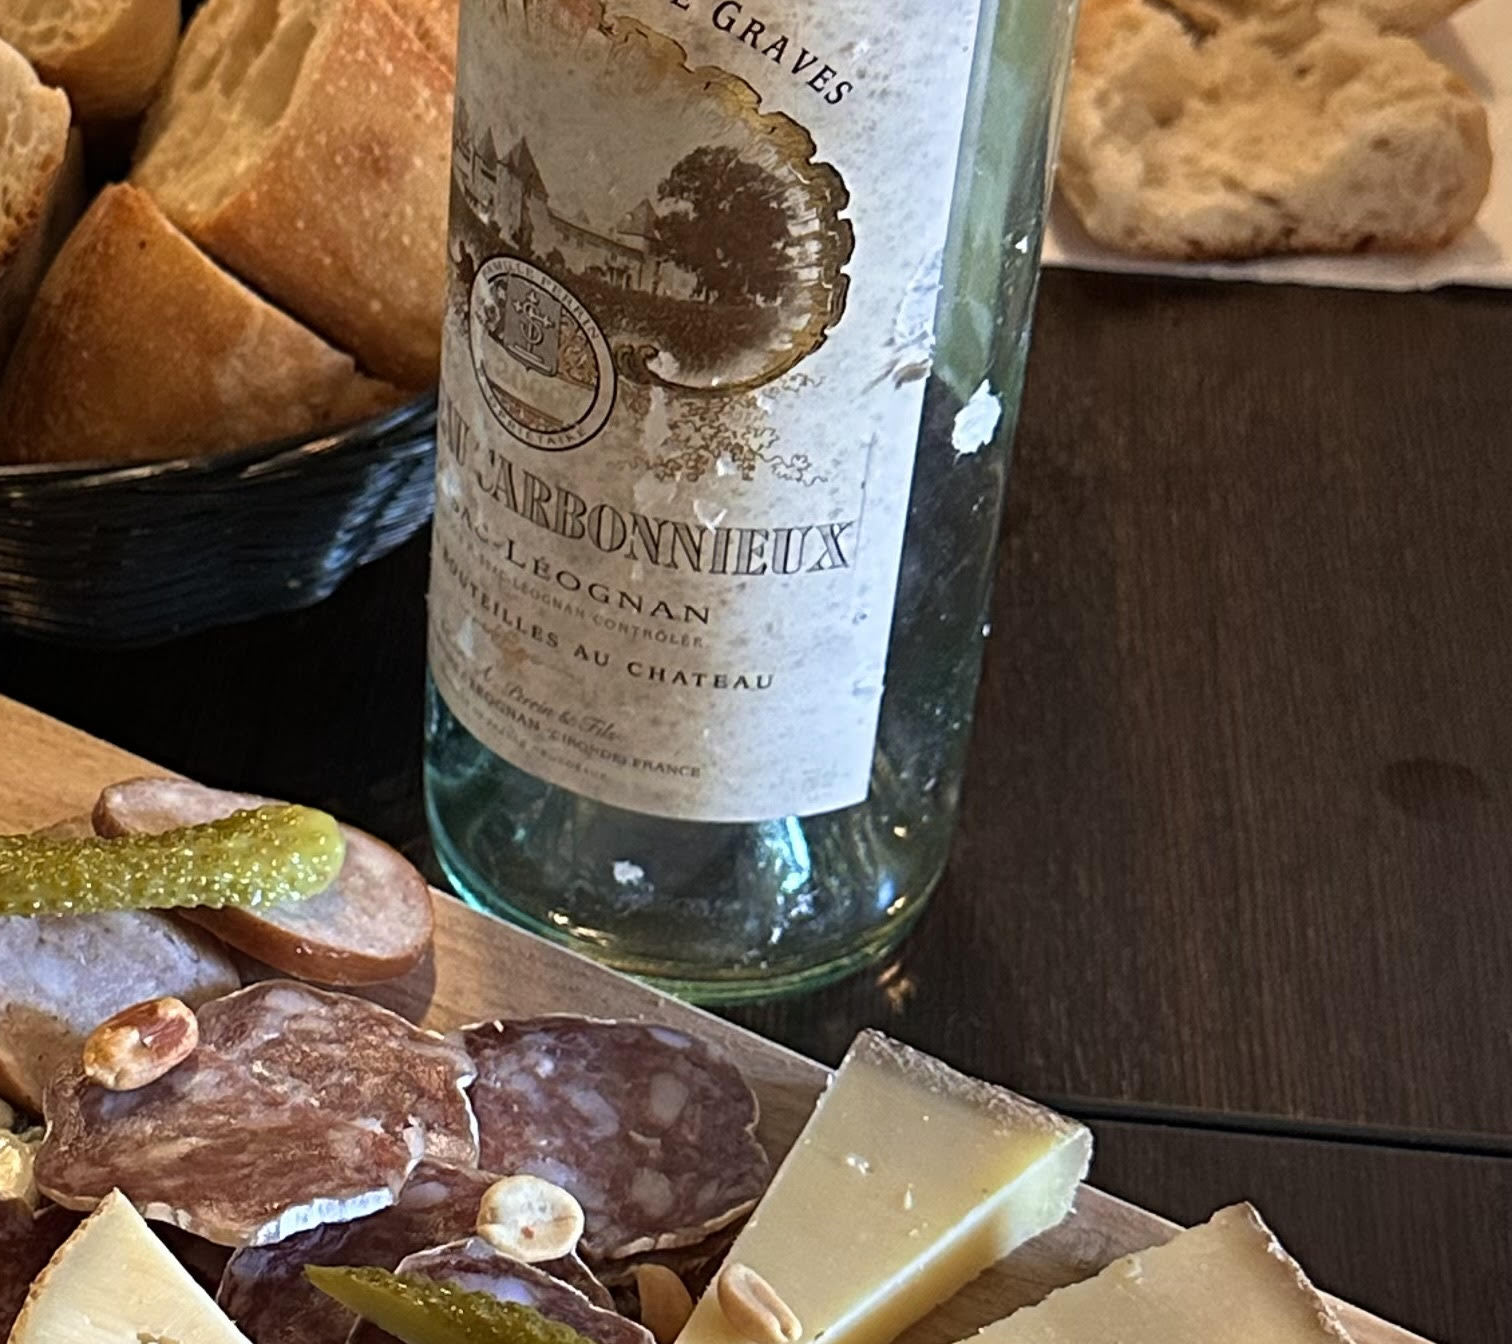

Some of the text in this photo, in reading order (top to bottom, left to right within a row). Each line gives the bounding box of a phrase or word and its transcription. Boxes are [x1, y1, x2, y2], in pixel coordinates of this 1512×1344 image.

[711, 0, 854, 105] GRAVES
[573, 643, 610, 667] AU
[627, 661, 775, 690] CHATEAU
